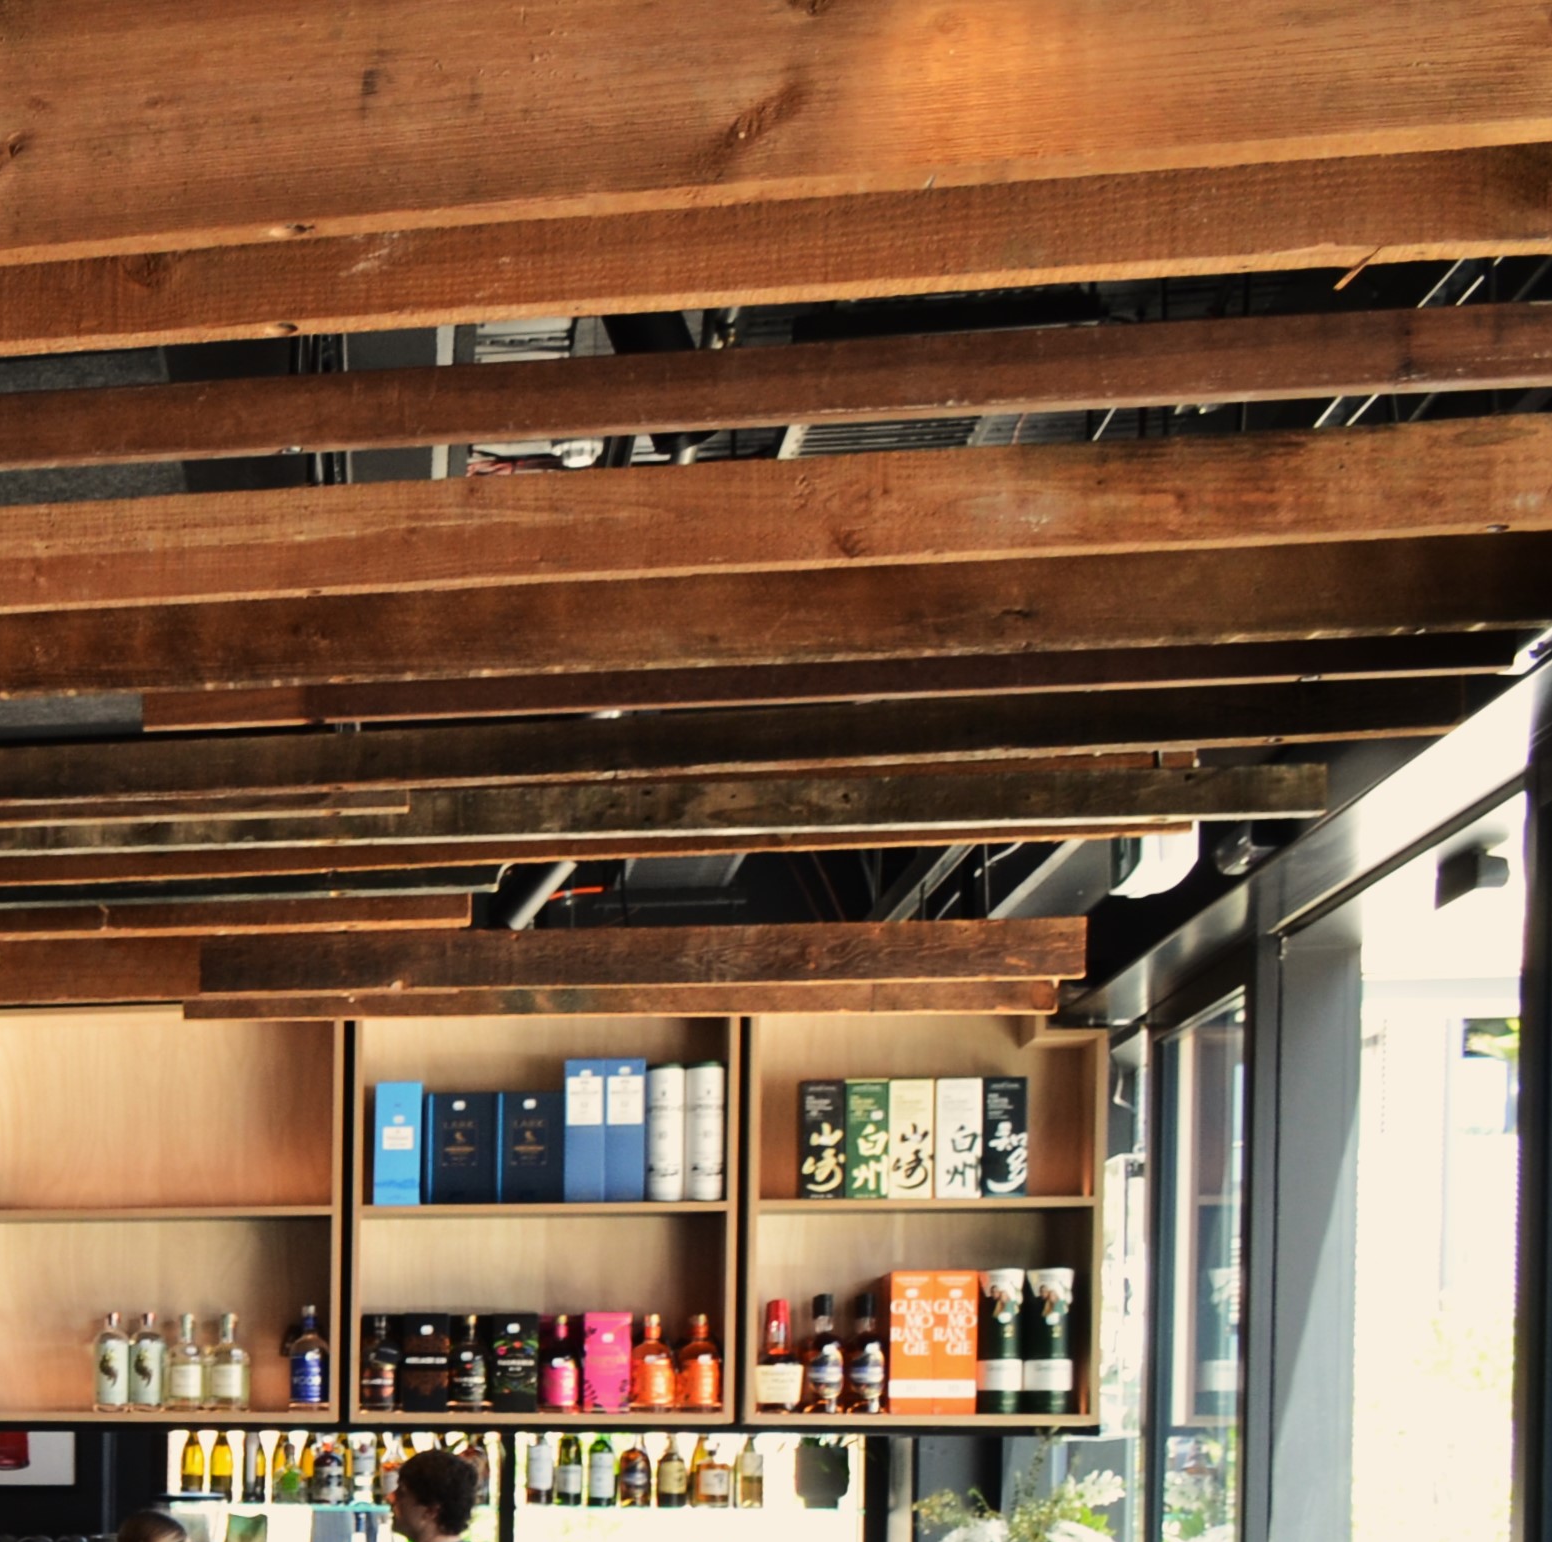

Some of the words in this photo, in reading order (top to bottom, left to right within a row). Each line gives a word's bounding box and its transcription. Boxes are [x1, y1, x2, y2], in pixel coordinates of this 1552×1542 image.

[891, 1299, 932, 1314] GLEN
[933, 1299, 975, 1314] GLEN
[905, 1313, 933, 1328] MO
[948, 1313, 978, 1328] MO
[890, 1327, 923, 1342] RAN
[932, 1327, 966, 1342] RAN
[903, 1340, 929, 1356] GIE
[945, 1340, 973, 1356] GIE
